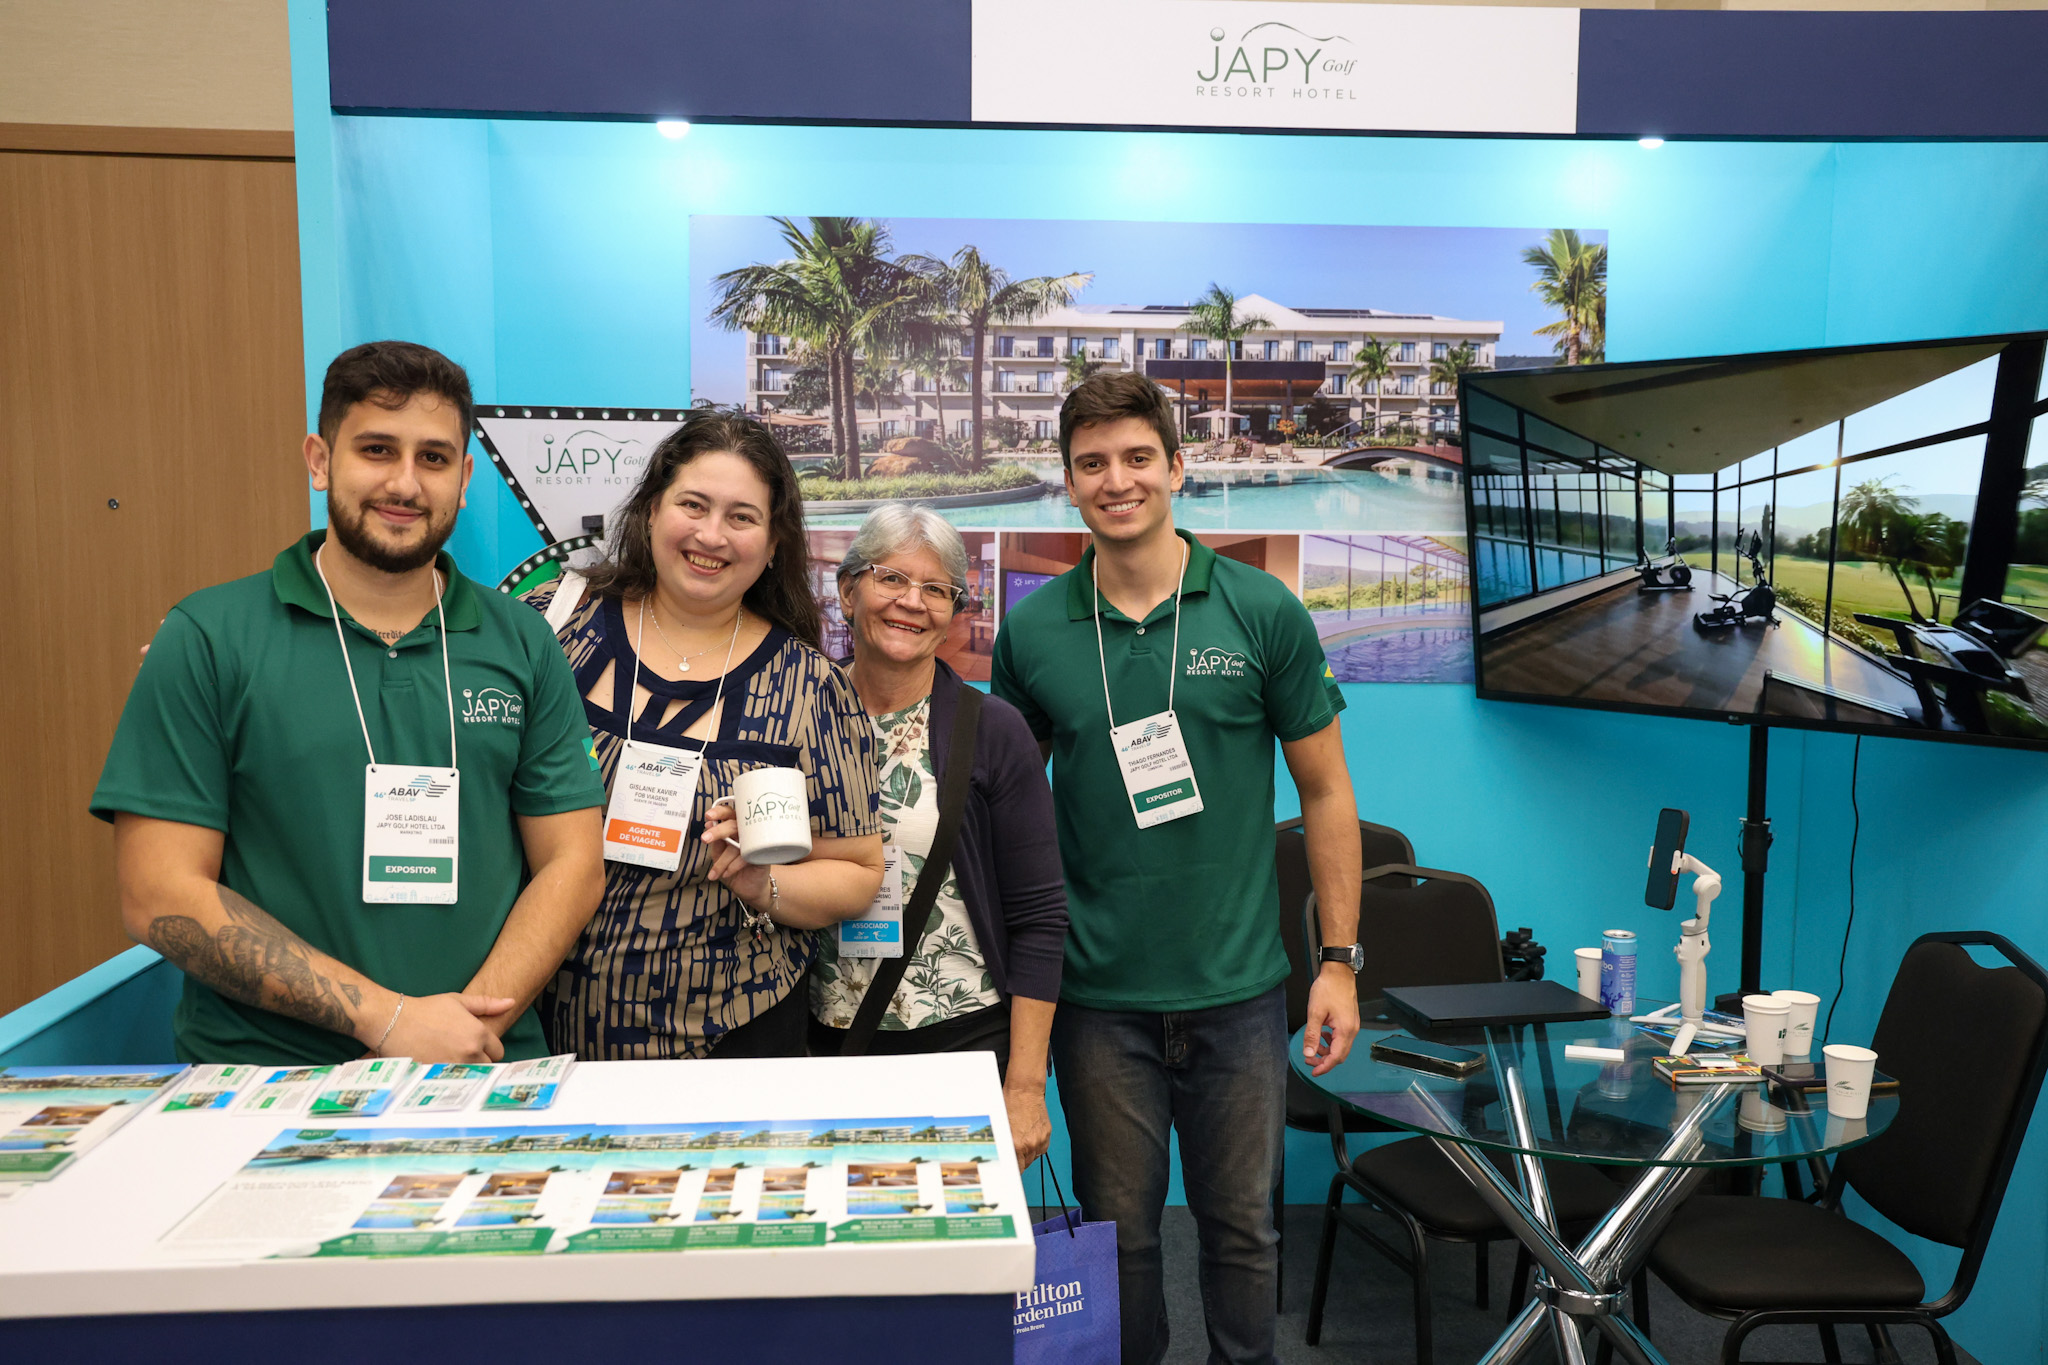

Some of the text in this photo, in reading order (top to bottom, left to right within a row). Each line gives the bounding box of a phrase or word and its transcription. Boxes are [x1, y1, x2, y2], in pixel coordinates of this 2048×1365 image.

[1197, 45, 1358, 84] JAPY Golf
[1196, 85, 1357, 100] RESORT HOTEL
[535, 447, 647, 474] JAPY Golf
[535, 476, 641, 485] RESORT HOTE
[1186, 655, 1246, 670] JAPY Golf
[1221, 669, 1245, 677] HOTEL
[462, 698, 511, 717] JAPY
[463, 715, 520, 725] RESORT HOTEL
[1130, 735, 1153, 748] ABAV
[1128, 747, 1176, 767] THIAGO FERNANDES
[1129, 753, 1178, 774] JAPY GOLF HOTEL LTDA
[638, 761, 668, 773] ABAV
[388, 787, 420, 797] ABAV
[629, 783, 678, 797] GISLAINE XAVIER
[1146, 787, 1183, 804] EXPOSITOR
[646, 793, 669, 803] VIAGENS
[745, 800, 788, 821] JAPY
[745, 815, 773, 826] RESORT
[628, 826, 661, 838] AGENTE
[619, 833, 666, 848] DE VIAGENS
[385, 865, 437, 875] EXPOSITOR
[1016, 1280, 1082, 1310] Hilton
